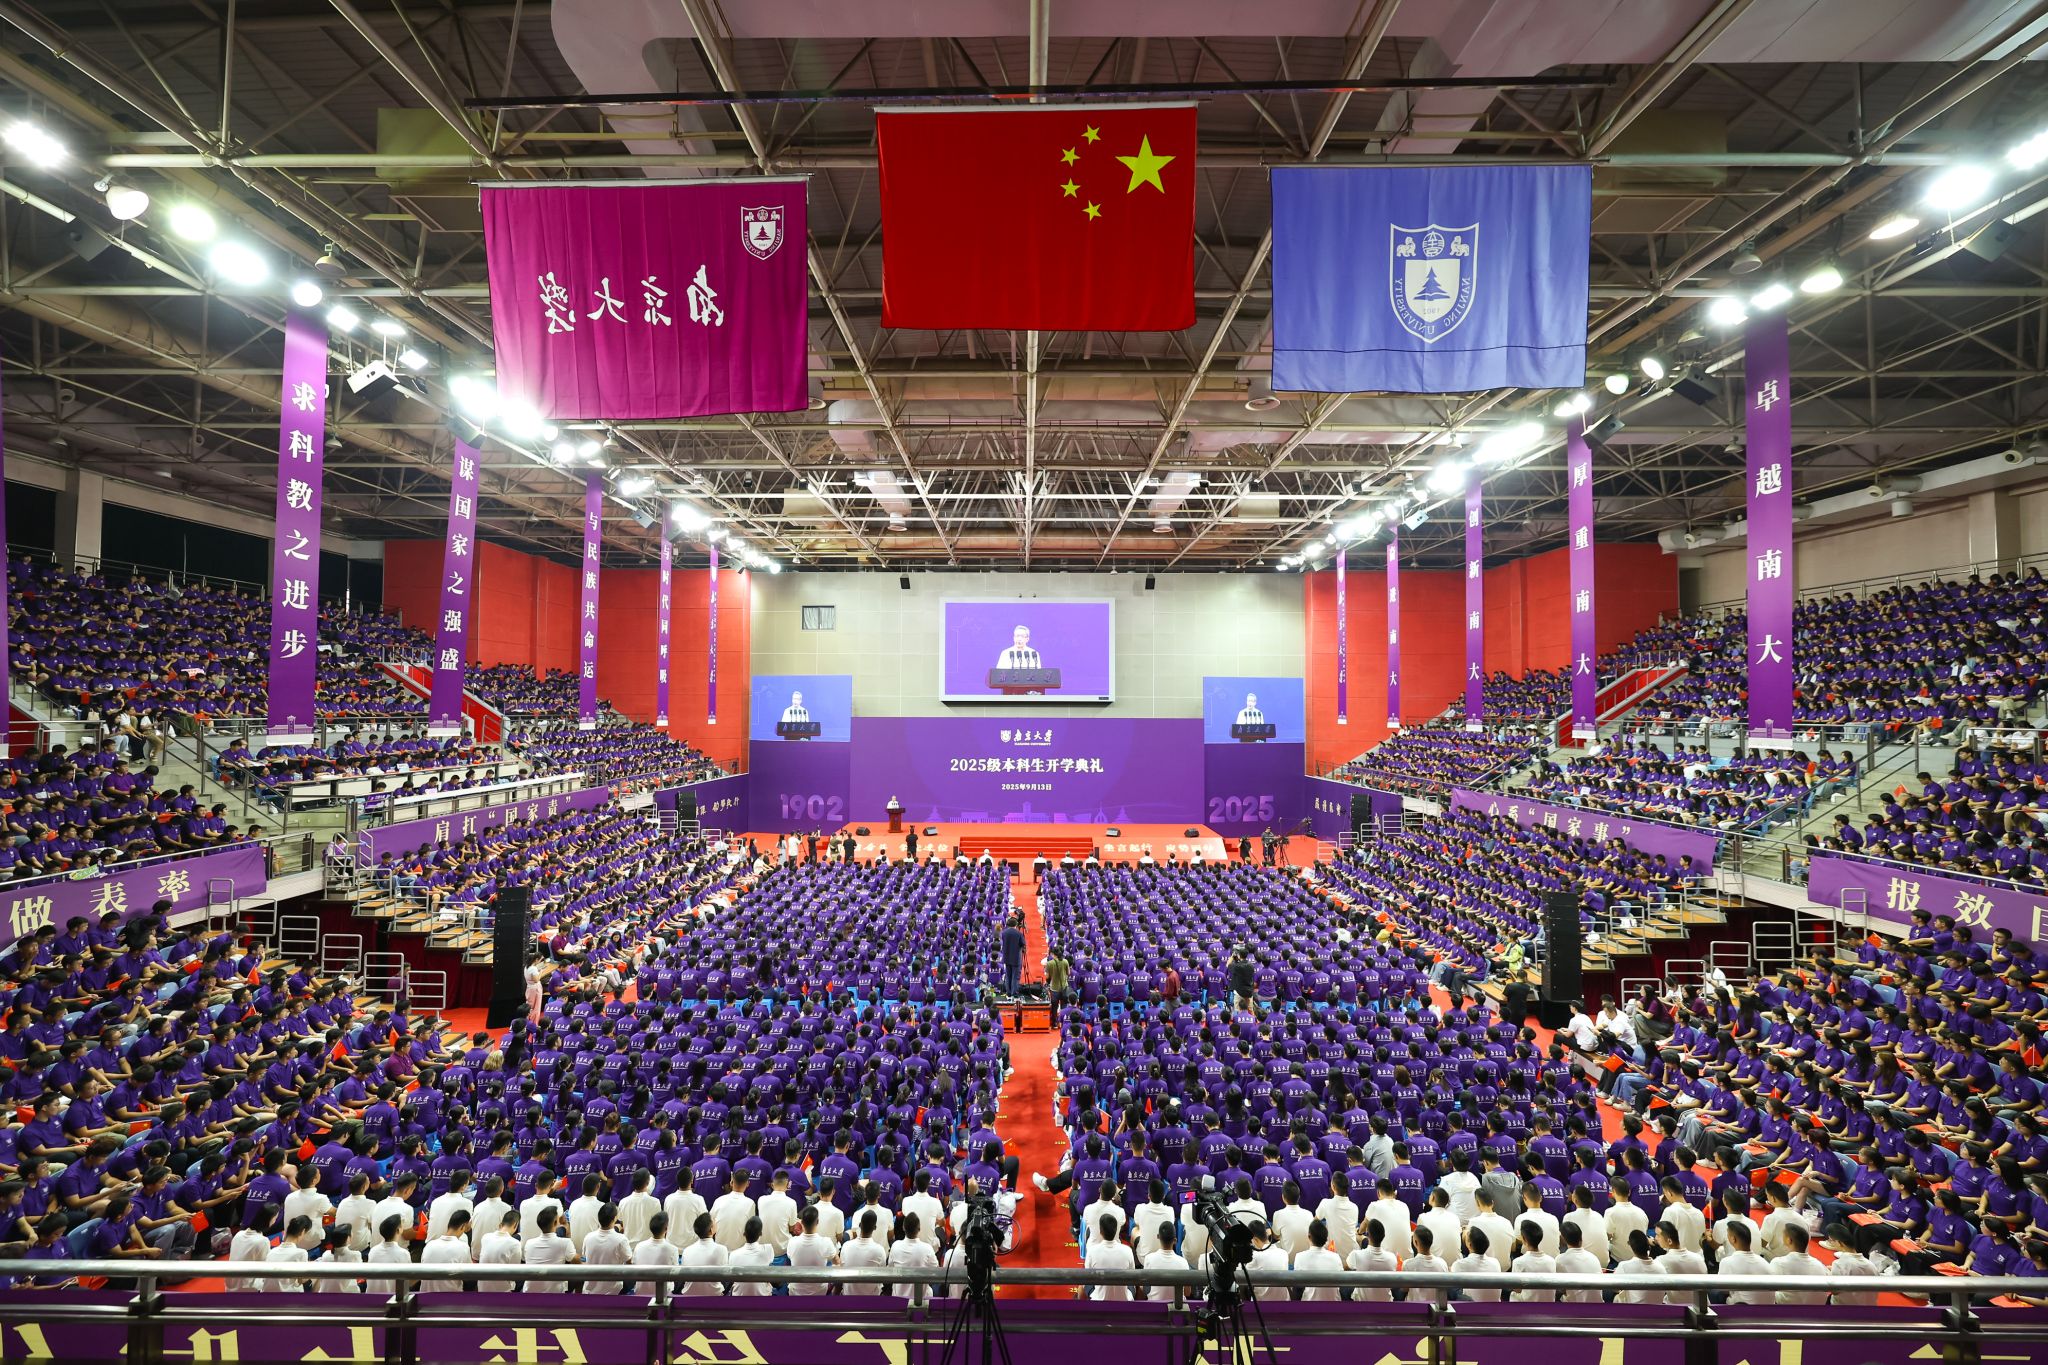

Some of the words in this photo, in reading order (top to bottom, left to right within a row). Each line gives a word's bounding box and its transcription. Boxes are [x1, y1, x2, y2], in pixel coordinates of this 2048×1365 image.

[280, 382, 318, 660] 求科教之进步
[439, 455, 476, 672] 谋国家之强盛
[583, 512, 600, 679] 与民族共命运
[1468, 508, 1480, 681] 创新南大
[1573, 462, 1591, 676] 厚重南大
[1755, 380, 1784, 665] 卓越南大
[780, 793, 844, 821] 1902
[950, 757, 1104, 773] 2025级本科生开学典礼
[1001, 783, 1052, 791] 2025年9月13日
[1209, 795, 1275, 823] 2025
[9, 870, 191, 938] 做表率
